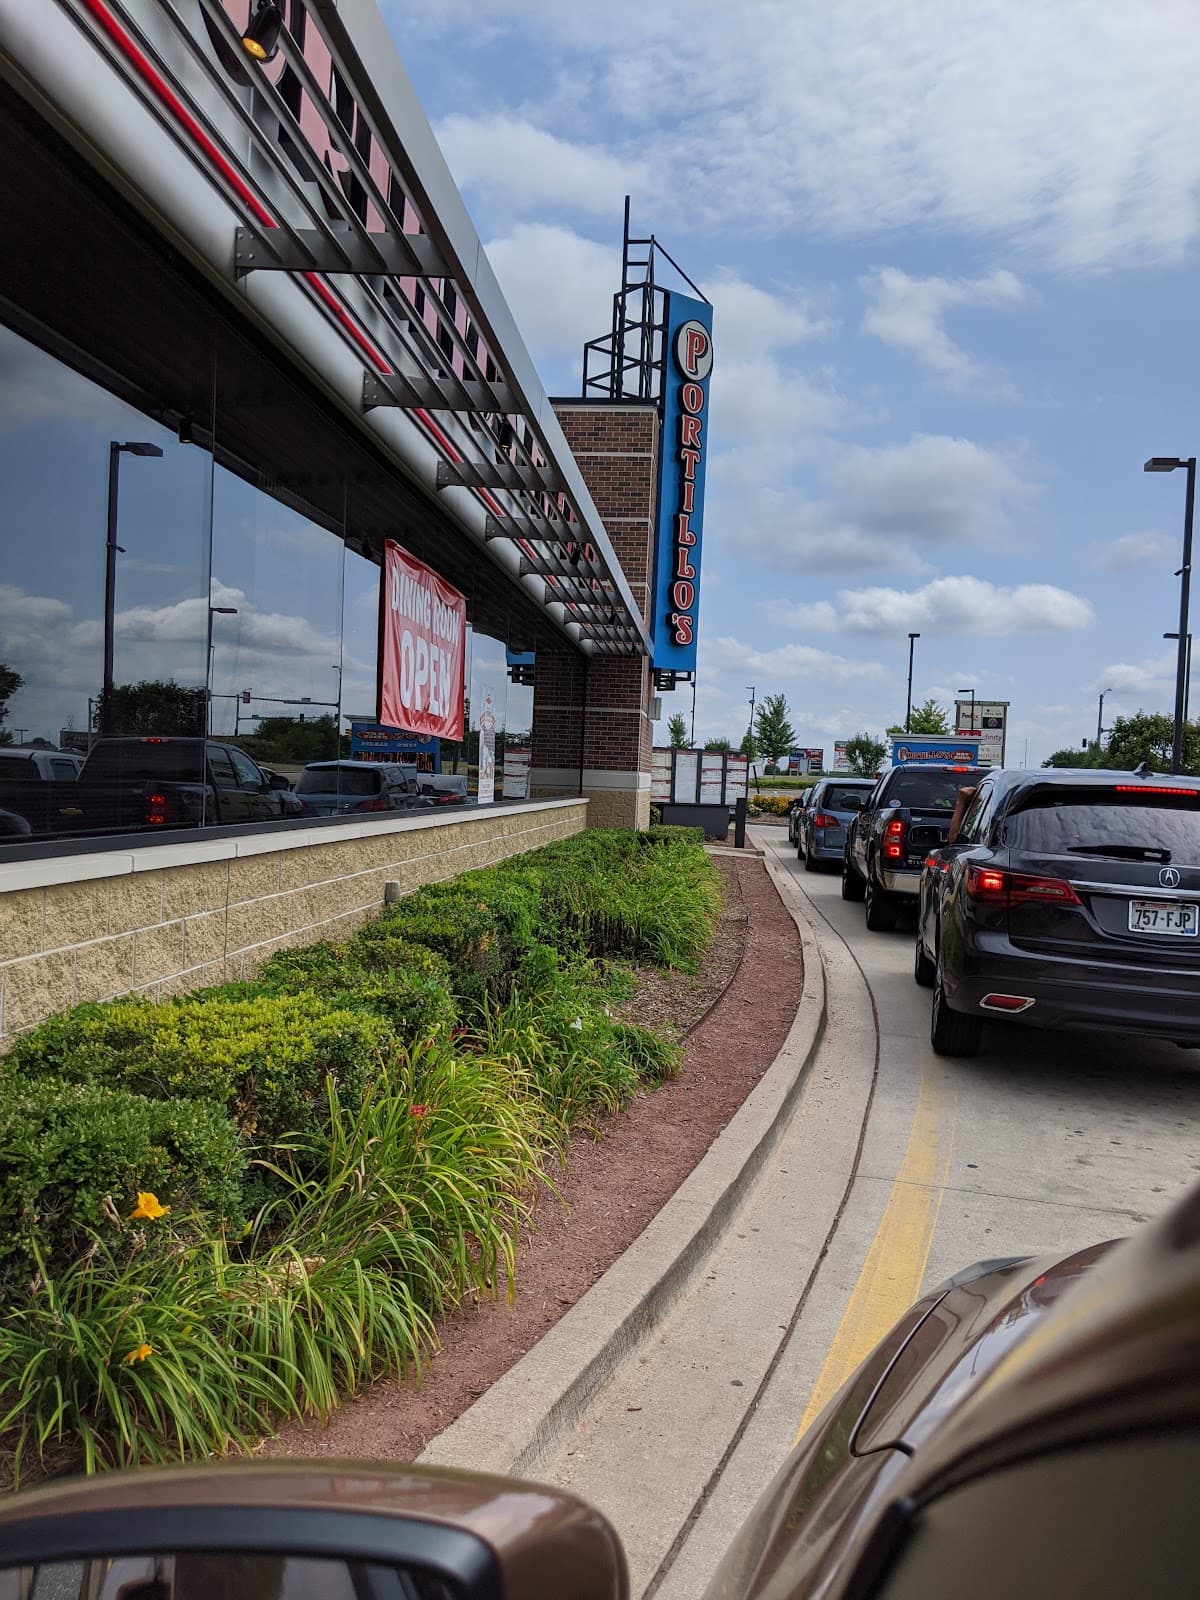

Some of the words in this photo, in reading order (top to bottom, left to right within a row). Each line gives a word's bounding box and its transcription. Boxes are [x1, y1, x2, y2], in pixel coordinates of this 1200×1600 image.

[672, 328, 708, 646] PORTILLO'S
[391, 565, 431, 630] DINING
[433, 595, 460, 647] ROOM
[400, 629, 452, 720] OPEN
[1135, 909, 1191, 929] 757-FJP
